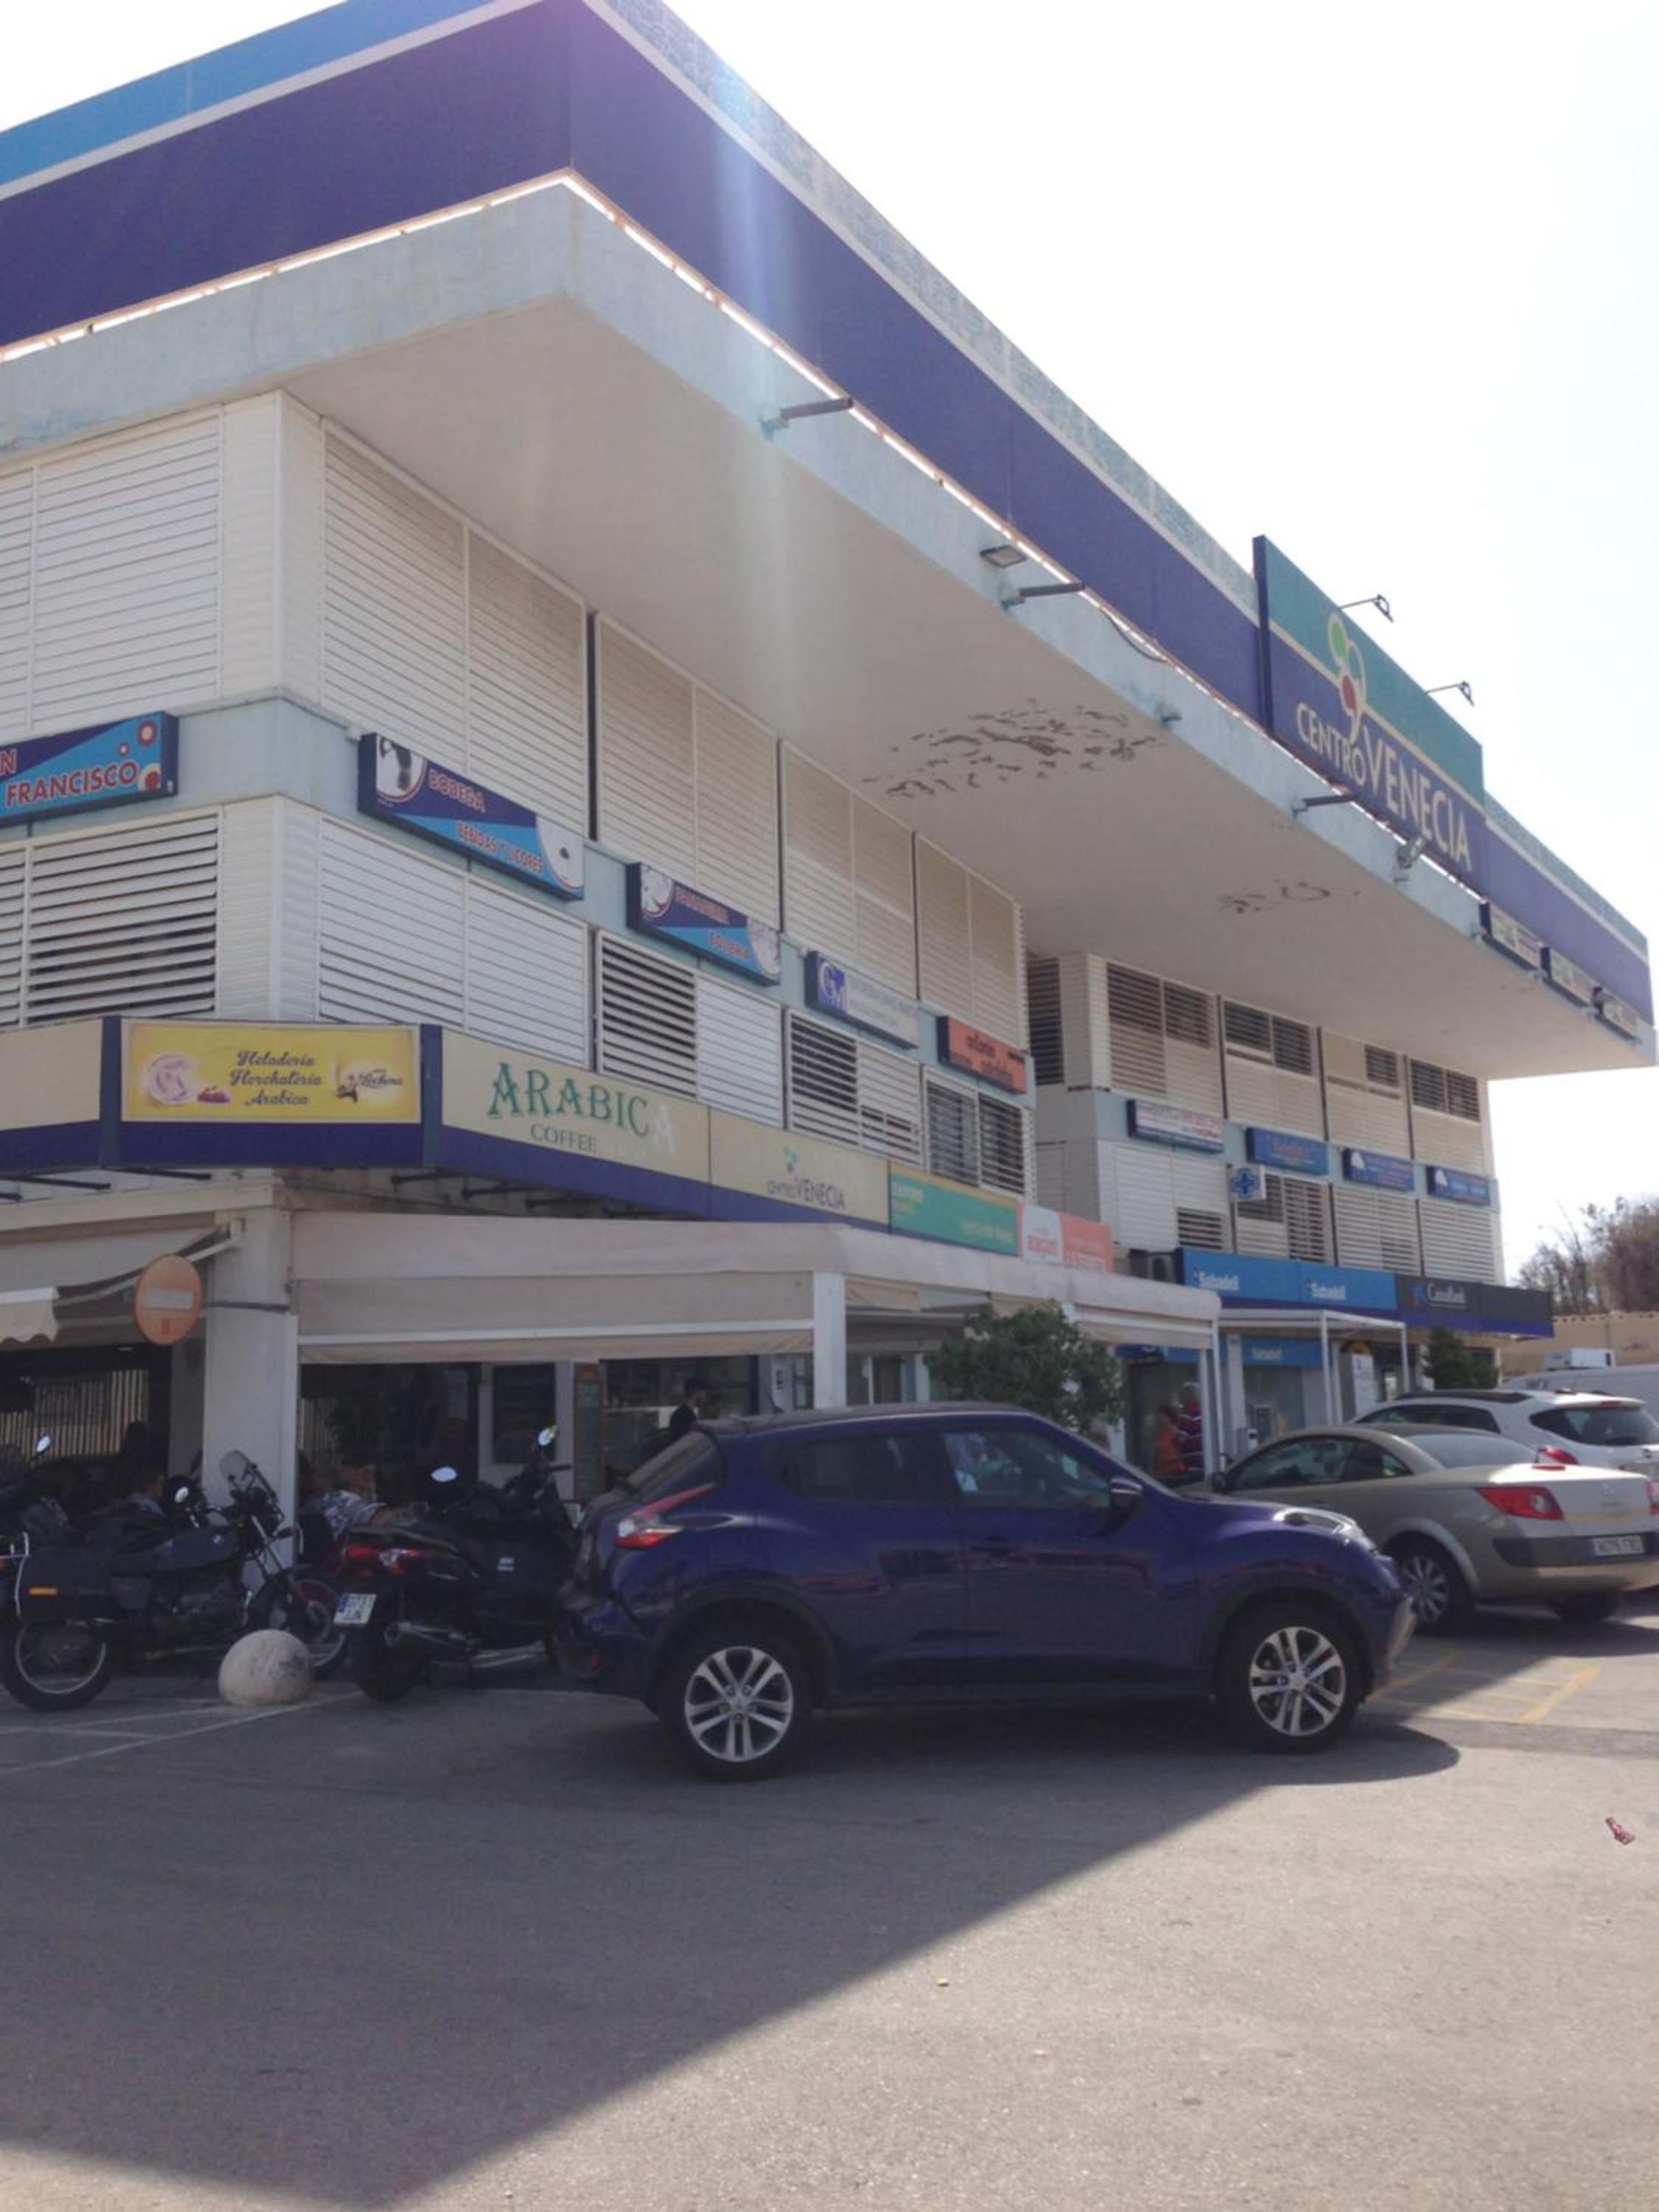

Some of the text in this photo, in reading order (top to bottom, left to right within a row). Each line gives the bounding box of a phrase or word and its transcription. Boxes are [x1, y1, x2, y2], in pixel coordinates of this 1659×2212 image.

[6, 760, 139, 808] FRANCISCO
[1297, 702, 1472, 872] CENTRO VENECIA
[530, 1122, 599, 1153] COFFEE
[795, 1177, 846, 1210] VENECIA
